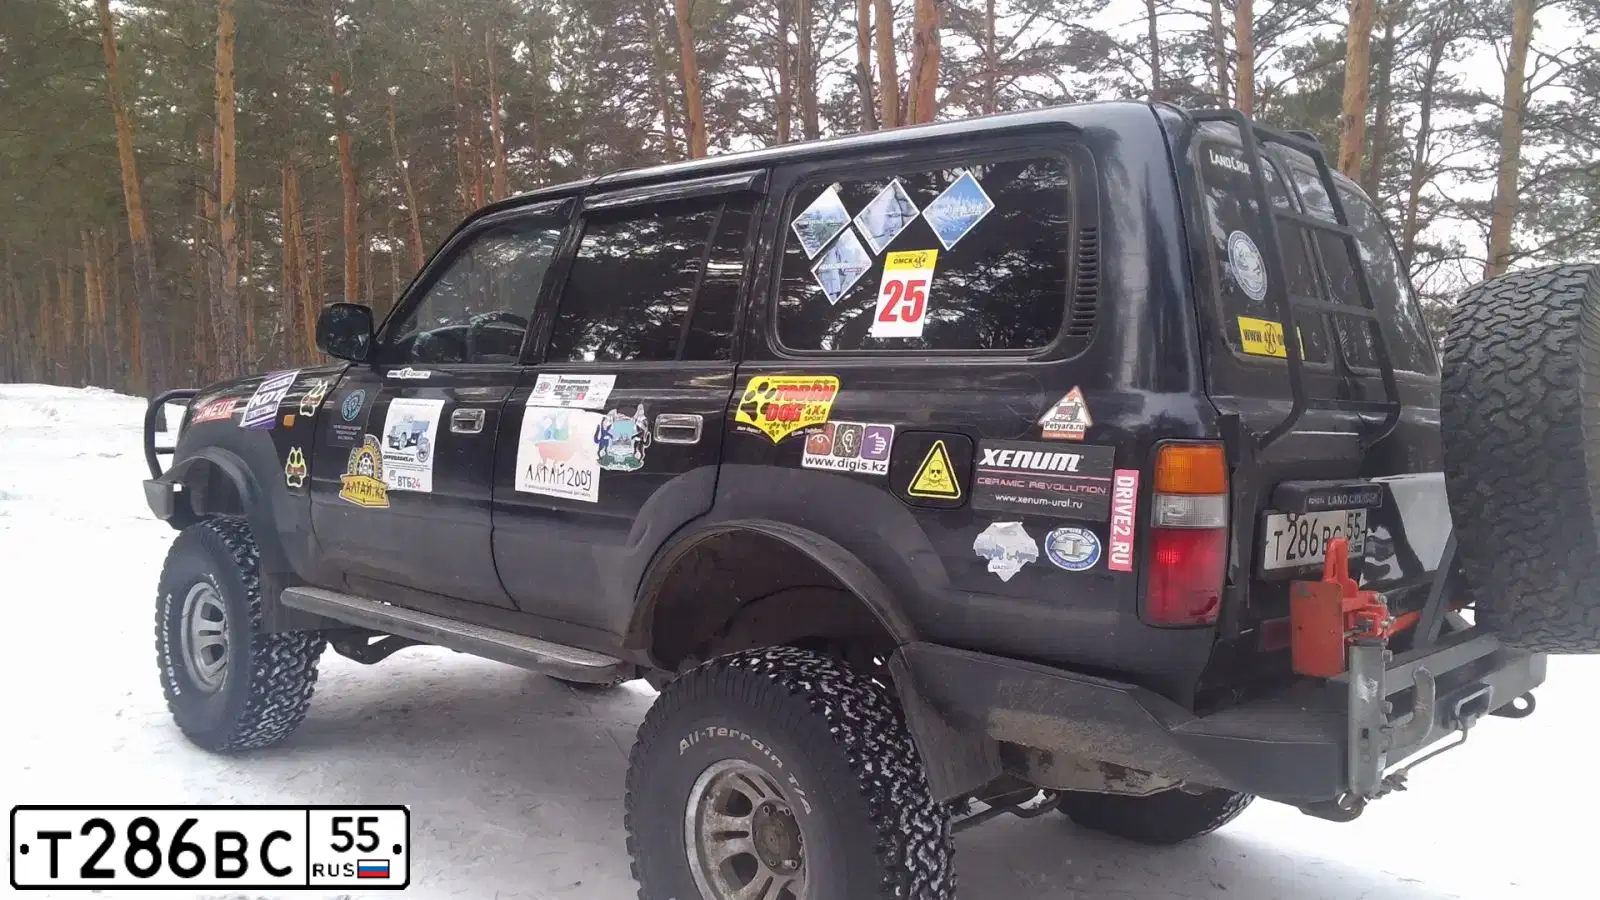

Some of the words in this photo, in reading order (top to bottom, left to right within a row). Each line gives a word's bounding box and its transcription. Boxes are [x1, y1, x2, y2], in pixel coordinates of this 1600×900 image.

[879, 280, 926, 323] 25
[805, 457, 886, 473] www.digis.kz
[979, 448, 1081, 473] XENUM
[977, 477, 1025, 489] CERAMIC
[1028, 481, 1107, 495] REVOLUTION
[995, 494, 1083, 510] www.xenum-ural.ru
[1327, 494, 1348, 506] LAND
[1111, 475, 1135, 566] DRIVE2.RU
[679, 726, 783, 769] All-Terrain
